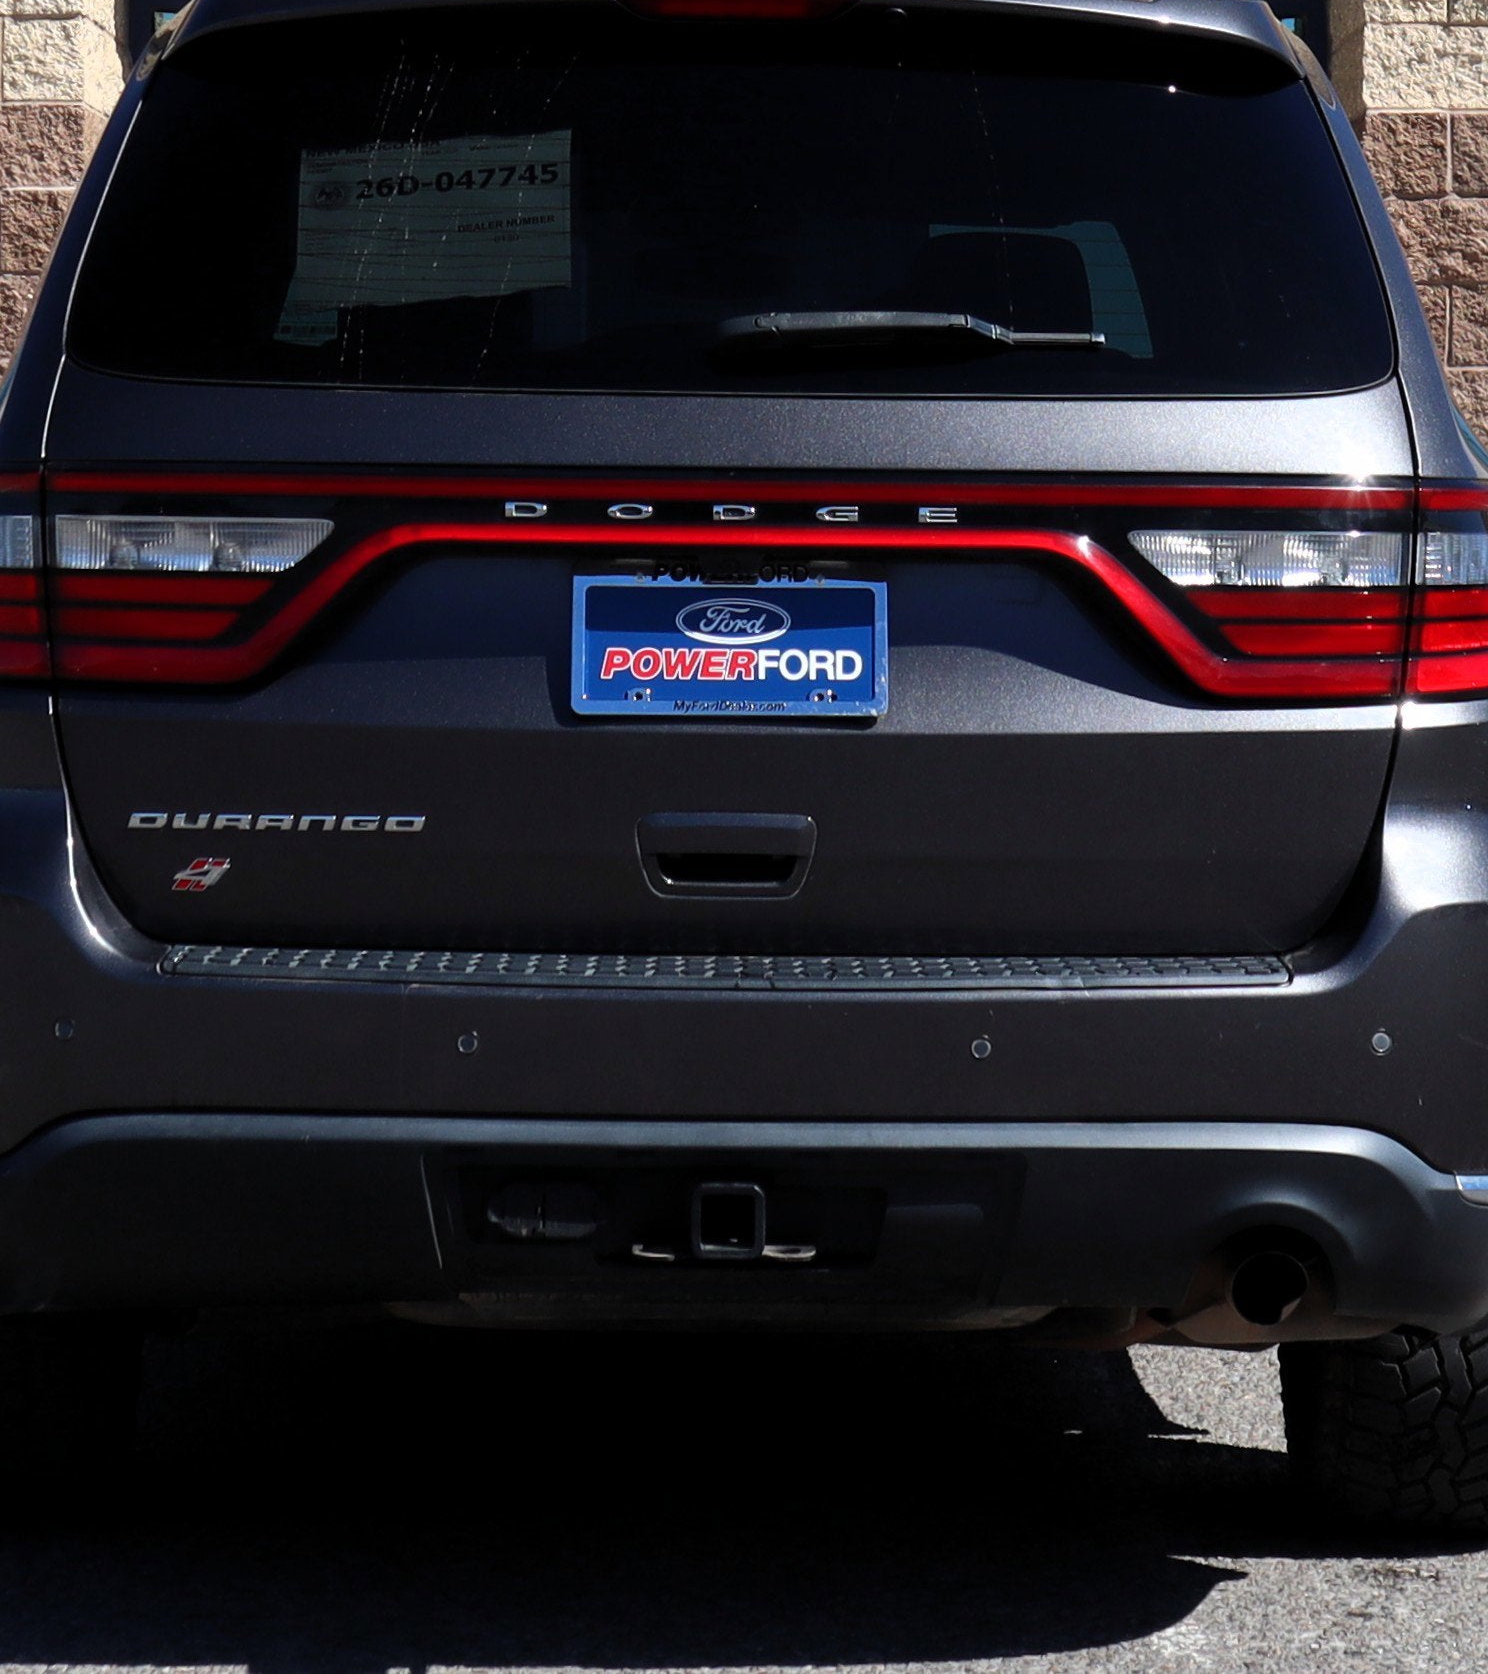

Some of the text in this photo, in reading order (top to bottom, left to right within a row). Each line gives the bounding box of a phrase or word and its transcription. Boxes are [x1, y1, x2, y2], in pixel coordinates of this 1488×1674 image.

[355, 163, 560, 200] 26D-047745
[457, 214, 556, 233] DEALER NUMBER
[504, 500, 959, 524] DODGE
[698, 605, 768, 634] Ford
[599, 646, 864, 681] POWERFORD
[126, 811, 428, 833] DURANGO
